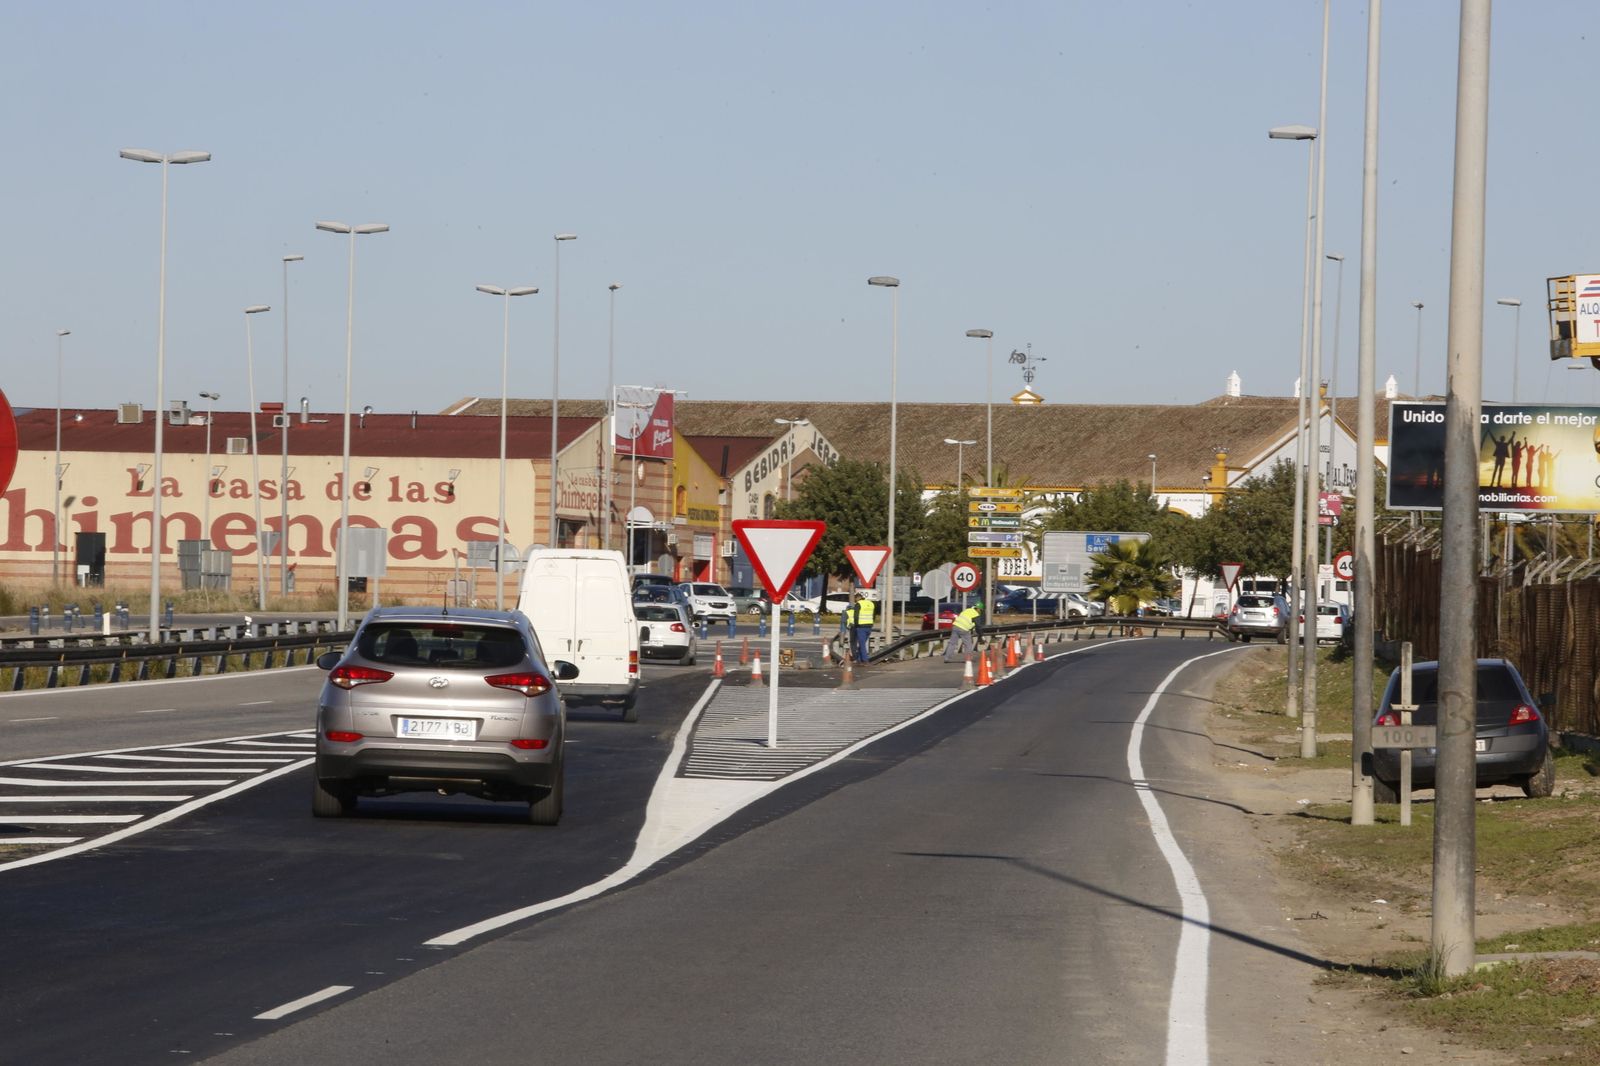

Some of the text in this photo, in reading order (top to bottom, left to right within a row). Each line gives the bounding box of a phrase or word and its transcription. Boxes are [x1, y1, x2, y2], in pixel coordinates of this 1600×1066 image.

[1403, 410, 1445, 423] Unido
[1493, 411, 1533, 424] darte
[1537, 412, 1550, 424] el
[1554, 412, 1597, 428] mejor
[745, 433, 795, 493] BEBIDAS
[126, 468, 456, 504] La casa de las
[1087, 544, 1107, 552] Sevi
[1003, 558, 1032, 576] DEL
[957, 572, 974, 582] 40
[410, 720, 442, 732] 2177
[1384, 730, 1413, 743] 100
